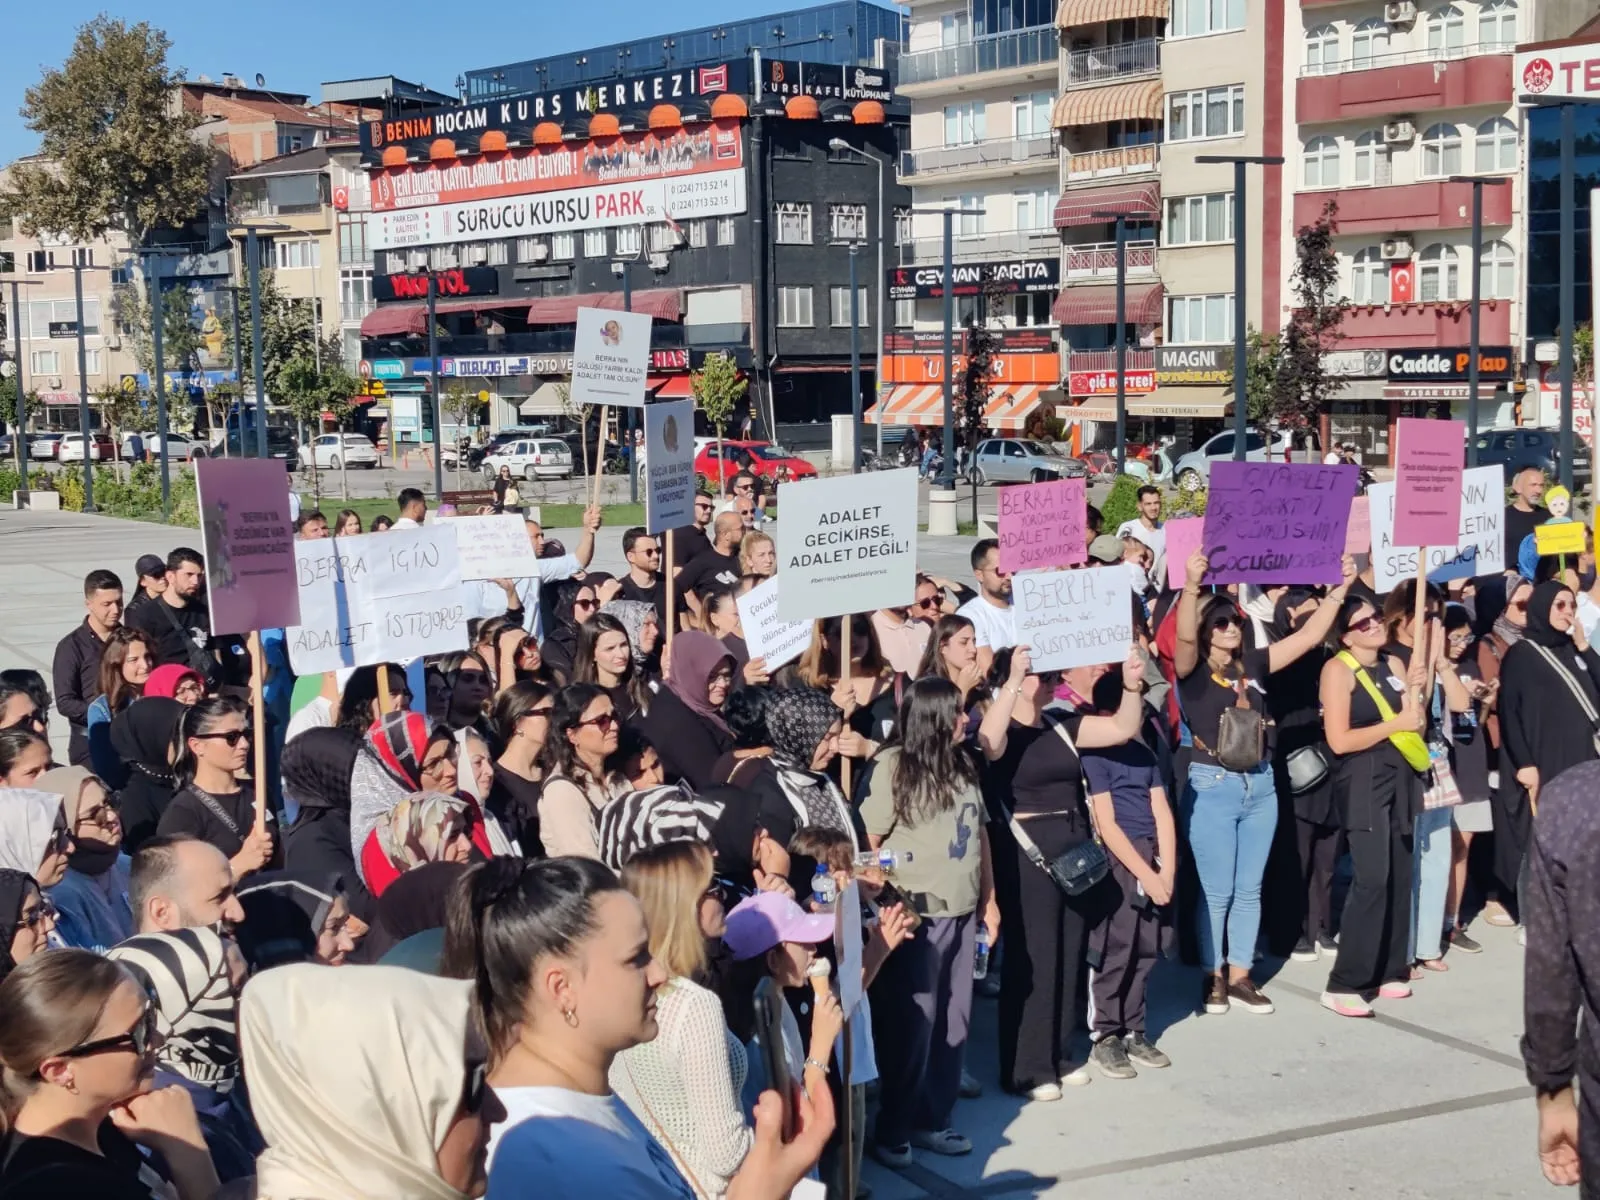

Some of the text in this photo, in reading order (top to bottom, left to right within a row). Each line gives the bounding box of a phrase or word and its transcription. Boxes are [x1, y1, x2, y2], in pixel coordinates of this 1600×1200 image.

[805, 85, 840, 96] KAFE
[845, 87, 890, 100] KÜTÜPHANE
[386, 117, 432, 142] BENİM
[435, 107, 487, 135] HOCAM
[501, 94, 561, 124] KURS
[505, 156, 535, 182] DEVAM
[537, 150, 572, 177] EDİYOR
[457, 202, 526, 236] SÜRÜCÜ
[530, 195, 591, 228] KURSU
[595, 189, 645, 220] PARK
[993, 260, 1049, 281] ARİTA
[532, 360, 558, 371] FOTO
[928, 357, 1004, 379] UĞR
[1389, 354, 1452, 374] Cadde
[818, 505, 882, 526] ADALET
[804, 523, 896, 548] GECİKİRSE,
[1000, 527, 1051, 549] ADALET
[789, 539, 910, 568] ADALET DEĞİL!
[1385, 551, 1418, 577] SES
[293, 622, 372, 653] ADALET
